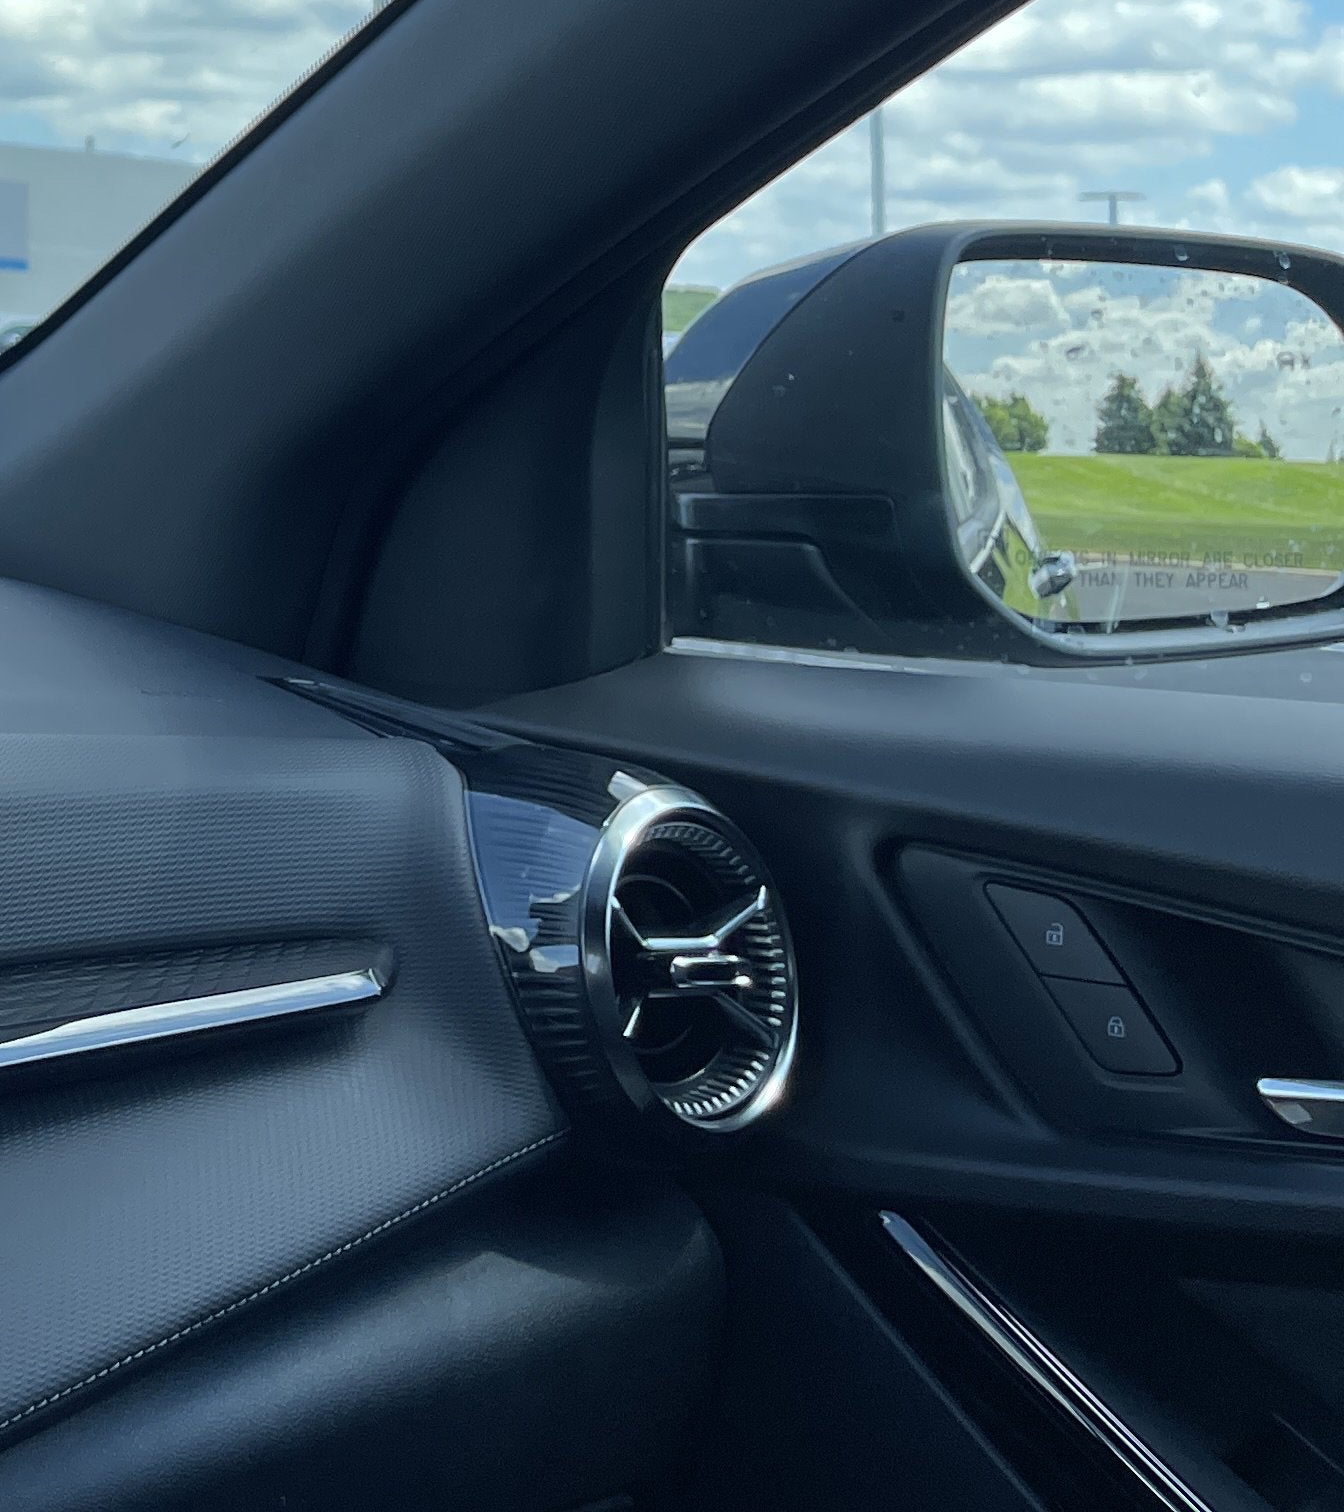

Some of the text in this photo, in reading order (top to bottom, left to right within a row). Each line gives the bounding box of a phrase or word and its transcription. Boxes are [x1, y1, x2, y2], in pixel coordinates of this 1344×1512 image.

[1129, 550, 1190, 568] MIRROR
[1202, 551, 1233, 569] ARE
[1243, 551, 1304, 568] CLOSER
[1134, 571, 1175, 588] THEY
[1185, 572, 1249, 589] APPEAR
